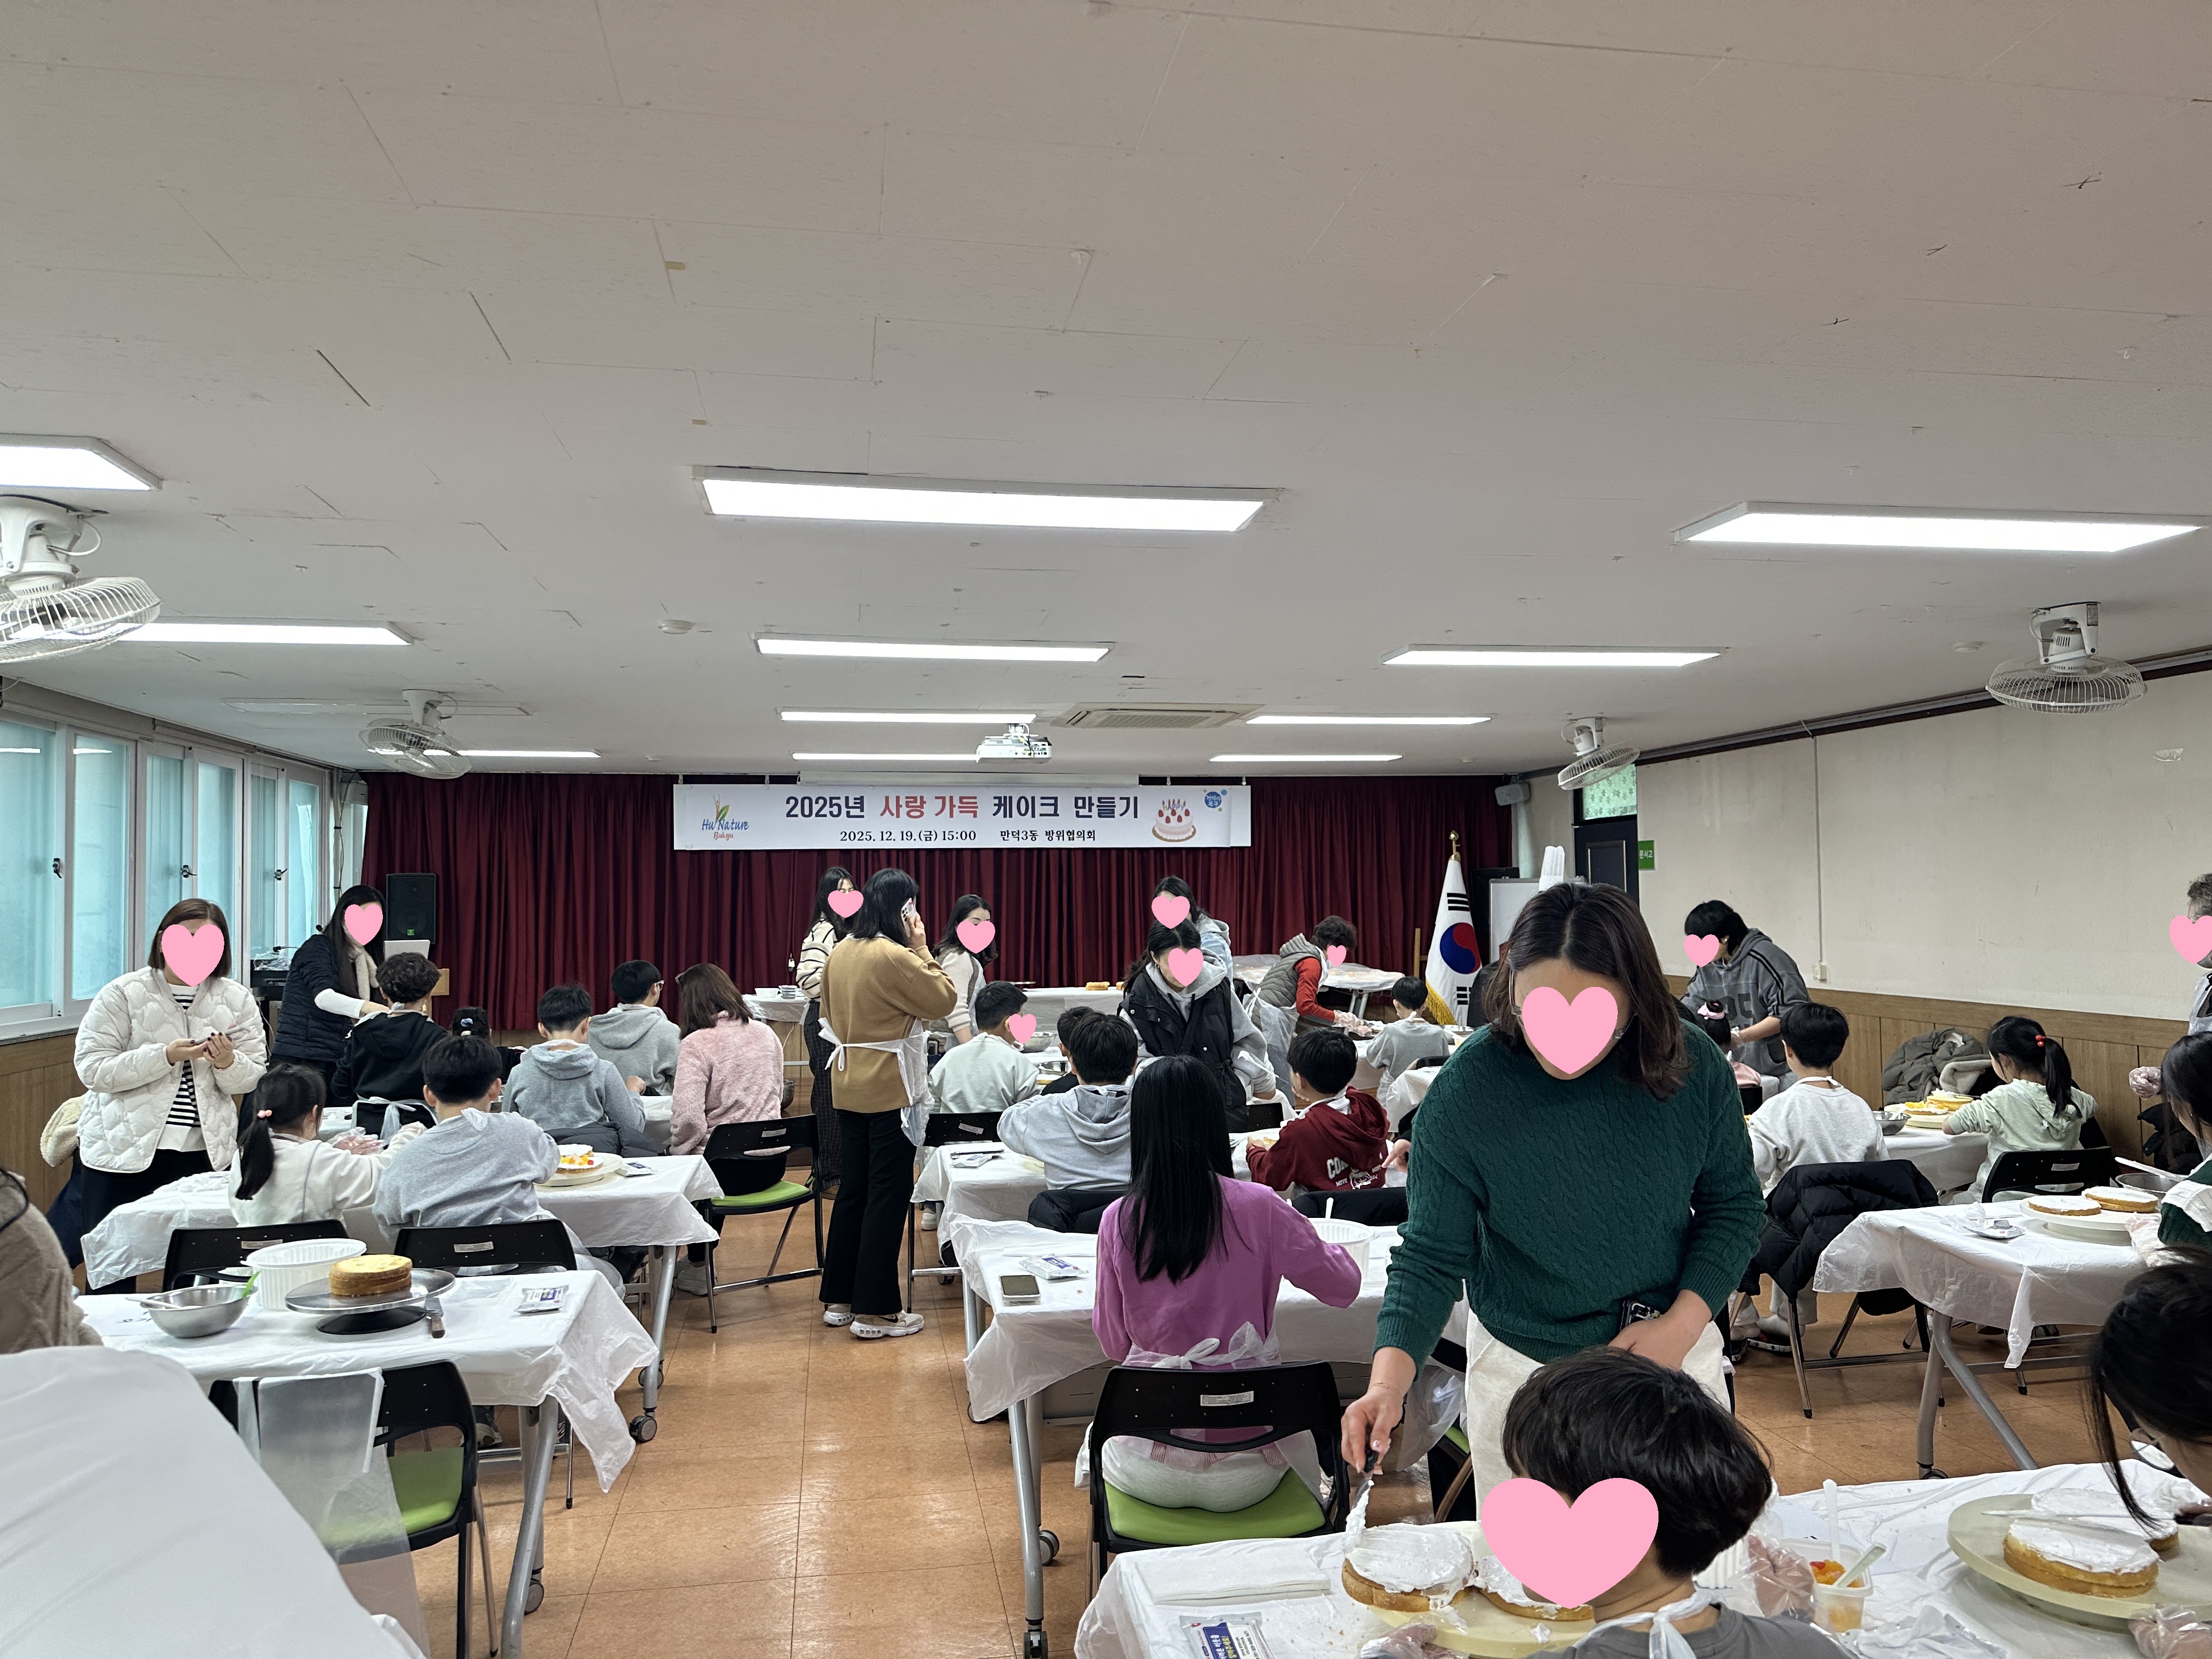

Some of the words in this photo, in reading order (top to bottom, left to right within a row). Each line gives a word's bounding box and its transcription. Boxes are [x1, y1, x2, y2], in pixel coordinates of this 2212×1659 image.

[786, 795, 865, 819] 2025년
[880, 795, 927, 819] 사랑
[934, 795, 979, 819] 가득
[992, 795, 1059, 819] 케이크
[1074, 796, 1138, 819] 만들기
[702, 819, 714, 831] Hu
[718, 818, 750, 831] Nature
[713, 831, 734, 841] Bukgu
[840, 831, 876, 842] 2025.
[880, 831, 896, 842] 12.
[942, 831, 977, 842] 15:00
[1000, 830, 1039, 842] 만덕3동
[1045, 830, 1096, 842] 방위협의회
